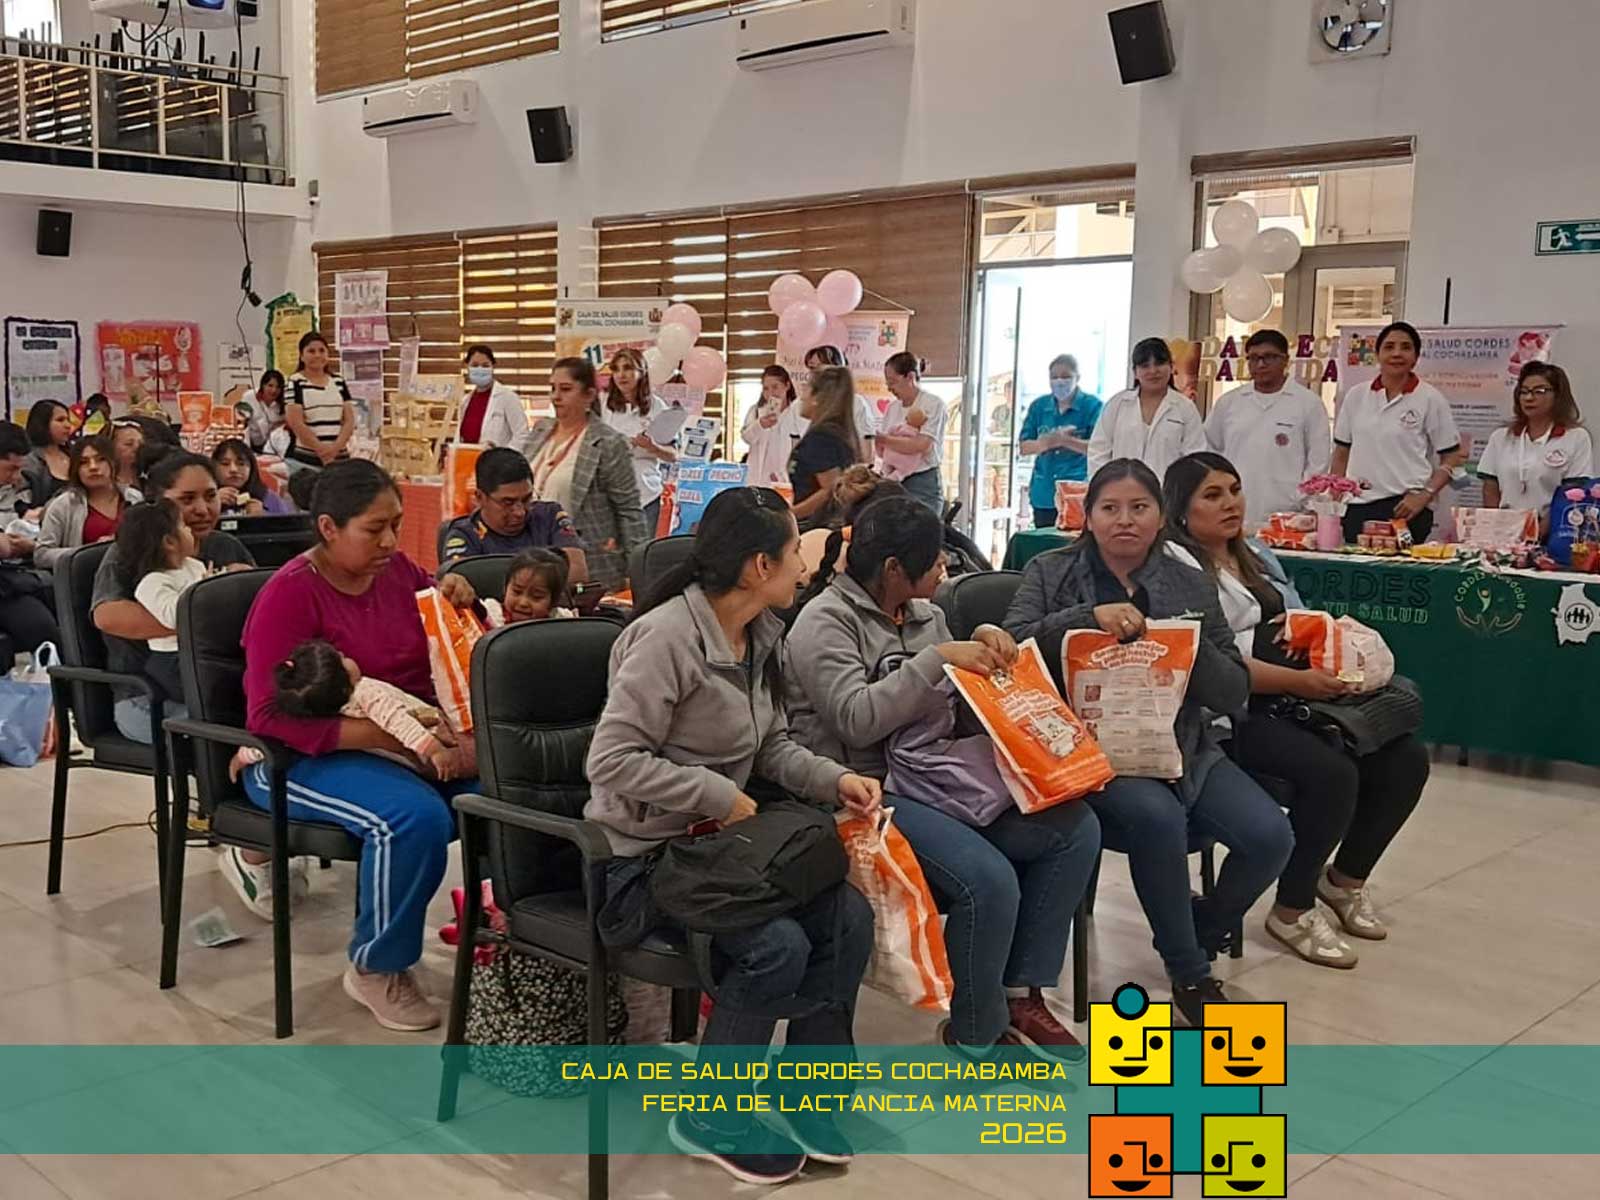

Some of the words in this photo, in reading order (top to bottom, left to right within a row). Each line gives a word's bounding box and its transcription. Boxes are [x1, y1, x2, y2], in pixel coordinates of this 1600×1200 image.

[1428, 338, 1460, 349] SALUD
[1465, 338, 1511, 349] CORDES
[1434, 350, 1499, 359] COCHABAMBA
[1293, 567, 1432, 608] ORDES
[1358, 603, 1429, 625] SALUD
